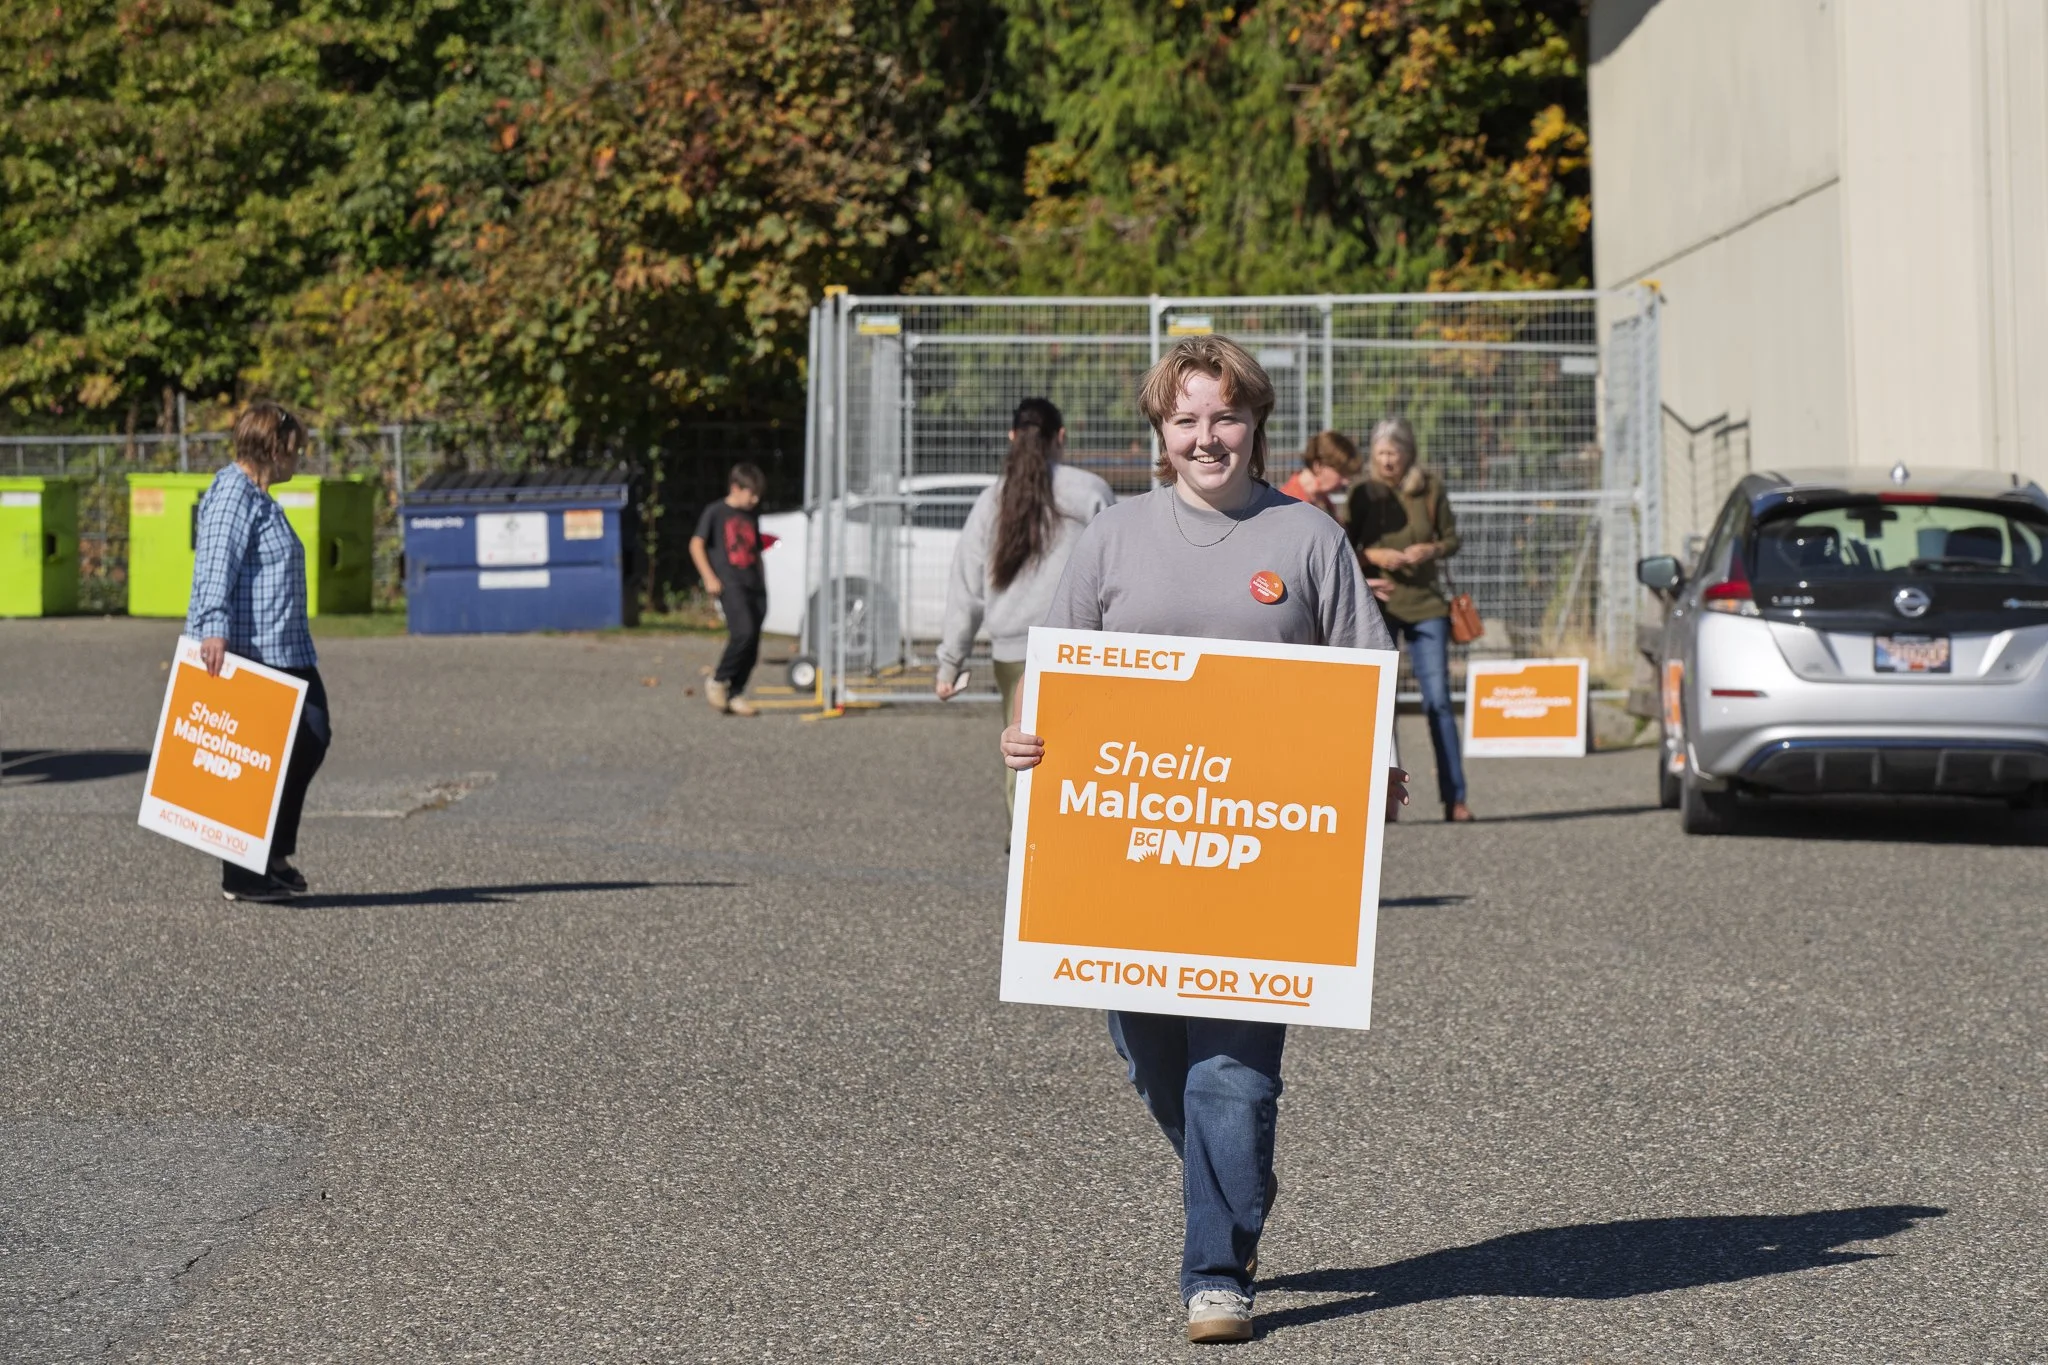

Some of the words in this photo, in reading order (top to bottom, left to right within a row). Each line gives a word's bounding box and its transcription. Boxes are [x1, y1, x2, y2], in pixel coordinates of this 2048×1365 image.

[1057, 643, 1186, 672] RE-ELECT
[189, 700, 239, 735] Sheila
[173, 717, 272, 771] Malcolmson
[1094, 741, 1232, 783] Sheila
[1059, 779, 1338, 836] Malcolmson
[159, 809, 198, 833] ACTION
[201, 825, 222, 843] FOR
[225, 836, 249, 853] YOU
[1133, 831, 1159, 848] BC
[1159, 829, 1262, 870] NDP
[1053, 958, 1168, 988] ACTION
[1178, 967, 1239, 993] FOR
[1249, 972, 1314, 999] YOU
